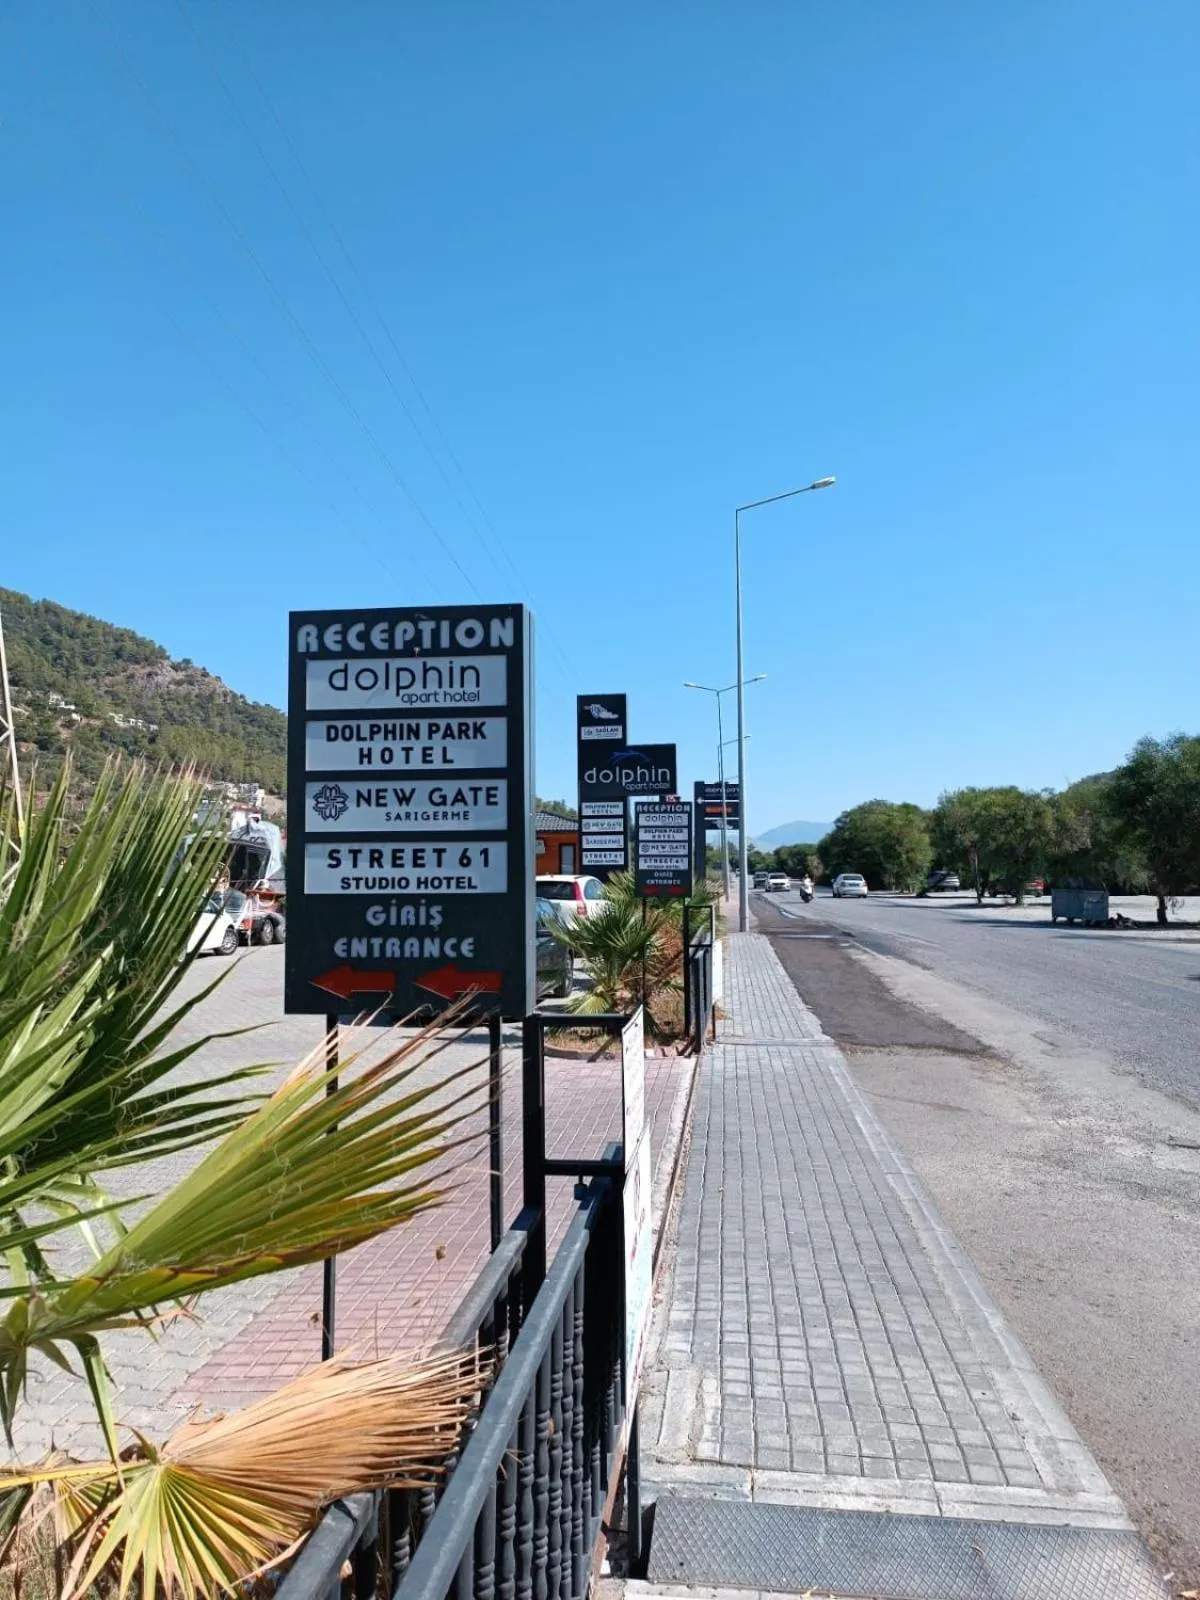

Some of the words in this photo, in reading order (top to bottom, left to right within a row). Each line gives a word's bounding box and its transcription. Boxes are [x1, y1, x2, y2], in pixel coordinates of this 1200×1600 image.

[297, 618, 514, 652] RECEPTION
[328, 661, 480, 697] dolphin
[401, 692, 440, 705] apart
[443, 690, 480, 702] hotel
[326, 723, 421, 742] DOLPHIN
[428, 721, 487, 741] PARK
[358, 746, 454, 765] HOTEL
[584, 765, 671, 787] dolphin
[356, 788, 416, 808] NEW
[428, 786, 499, 807] GATE
[385, 810, 470, 822] SARIGERME
[636, 804, 690, 813] RECEPTION
[327, 848, 447, 869] STREET
[459, 847, 490, 868] 61
[340, 877, 410, 890] STUDIO
[416, 876, 478, 889] HOTEL
[333, 937, 475, 958] ENTRANCE
